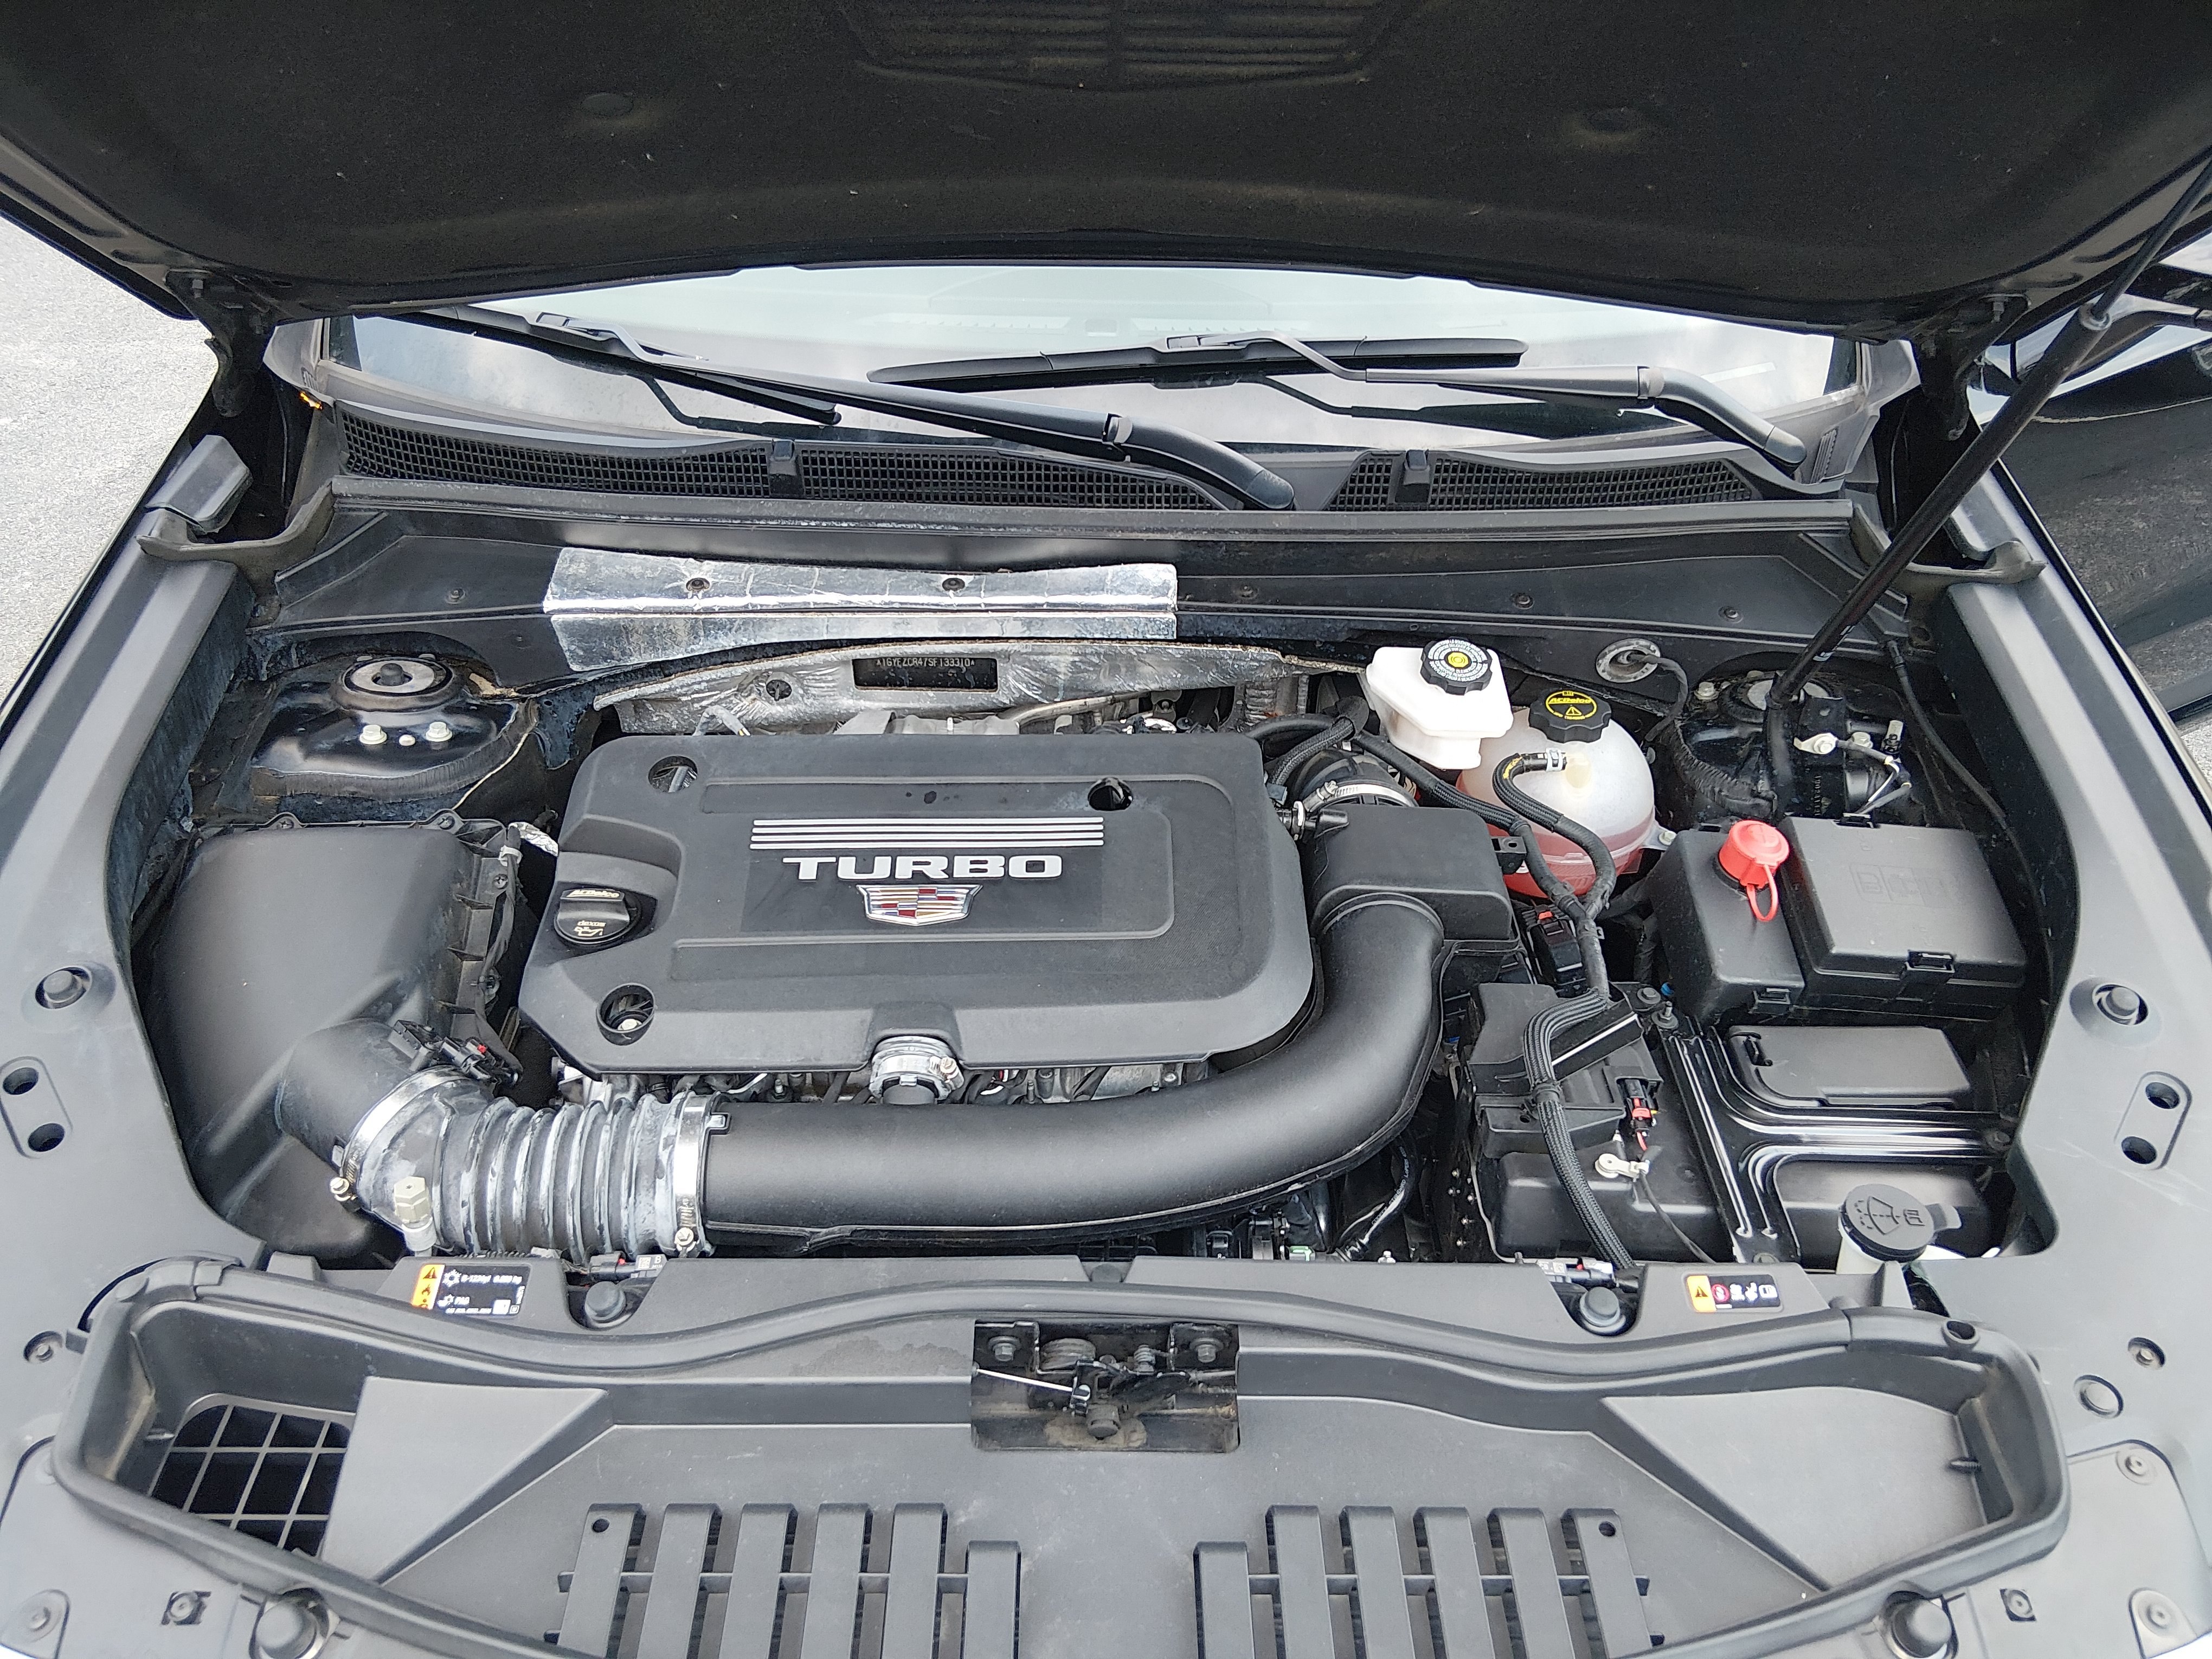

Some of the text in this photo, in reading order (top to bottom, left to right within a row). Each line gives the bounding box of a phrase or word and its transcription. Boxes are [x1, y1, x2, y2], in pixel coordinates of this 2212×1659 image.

[782, 855, 1063, 880] TURBO
[566, 890, 620, 898] ACDelco
[654, 1255, 662, 1264] B
